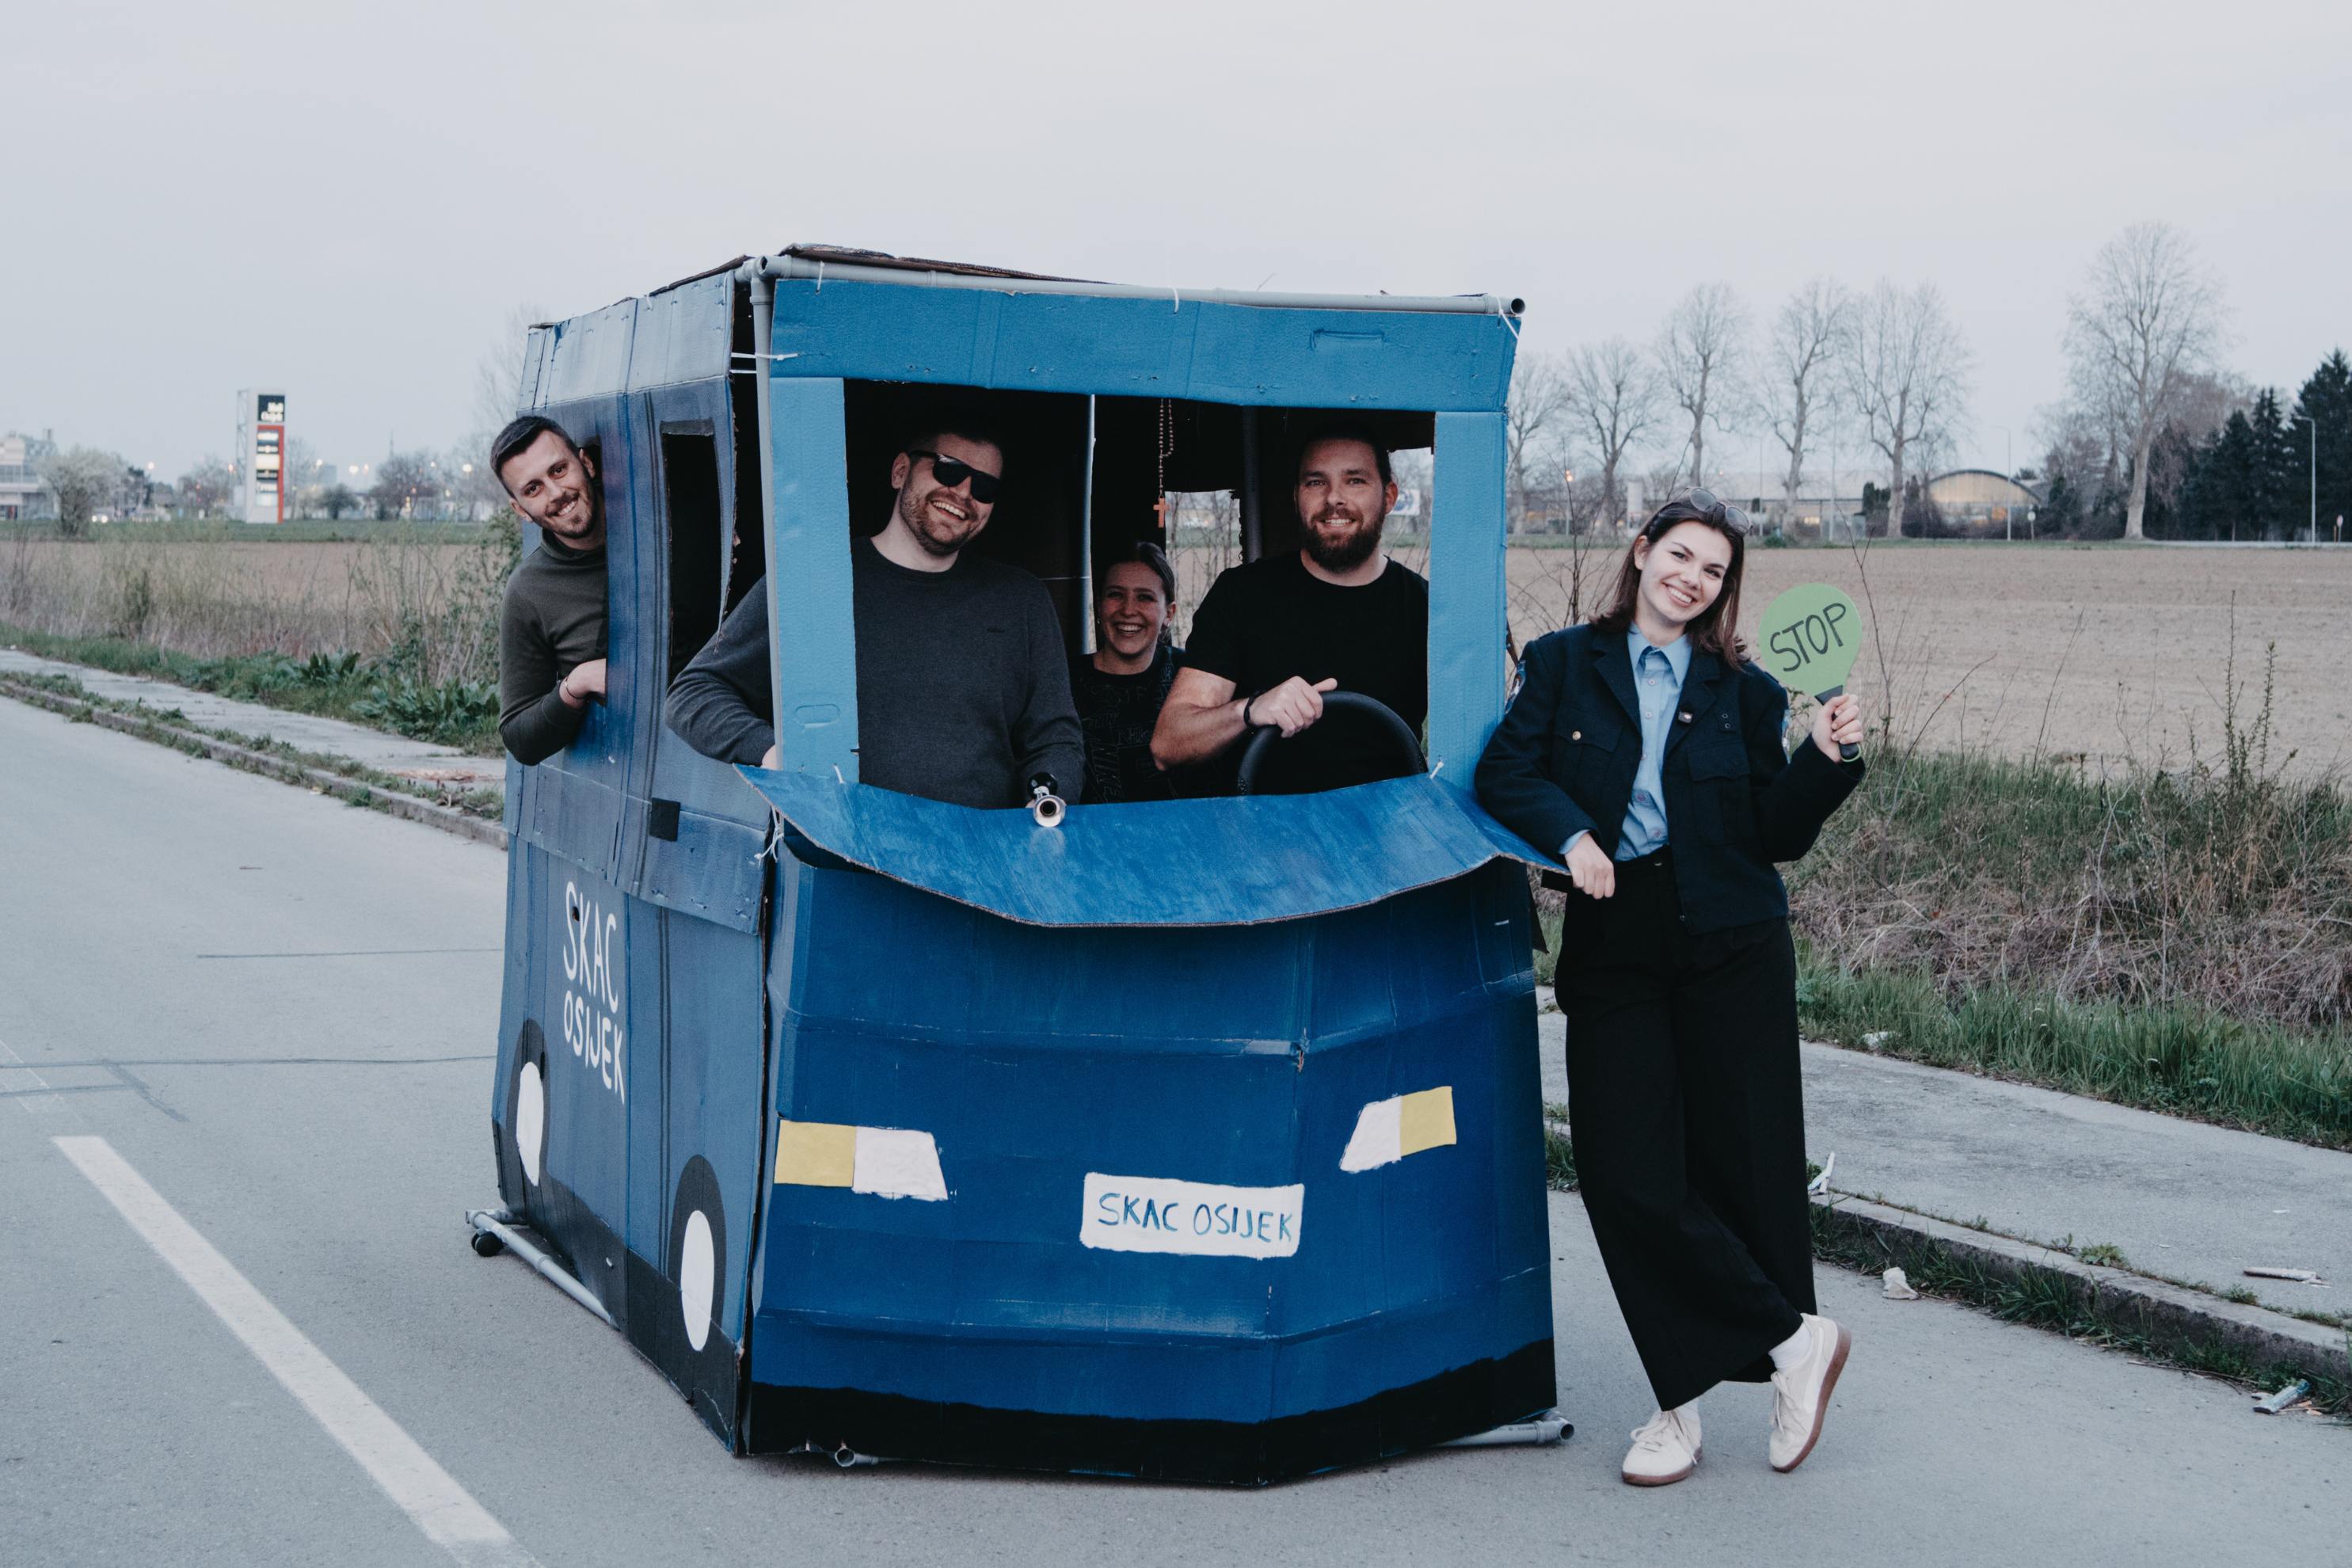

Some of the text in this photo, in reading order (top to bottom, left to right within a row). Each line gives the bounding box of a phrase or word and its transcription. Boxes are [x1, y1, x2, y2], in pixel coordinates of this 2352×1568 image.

[1769, 602, 1847, 672] STOP
[563, 880, 618, 1014] SKAC
[563, 989, 626, 1106] OSIJEK
[1098, 1192, 1293, 1243] SKAC OSIJEK
